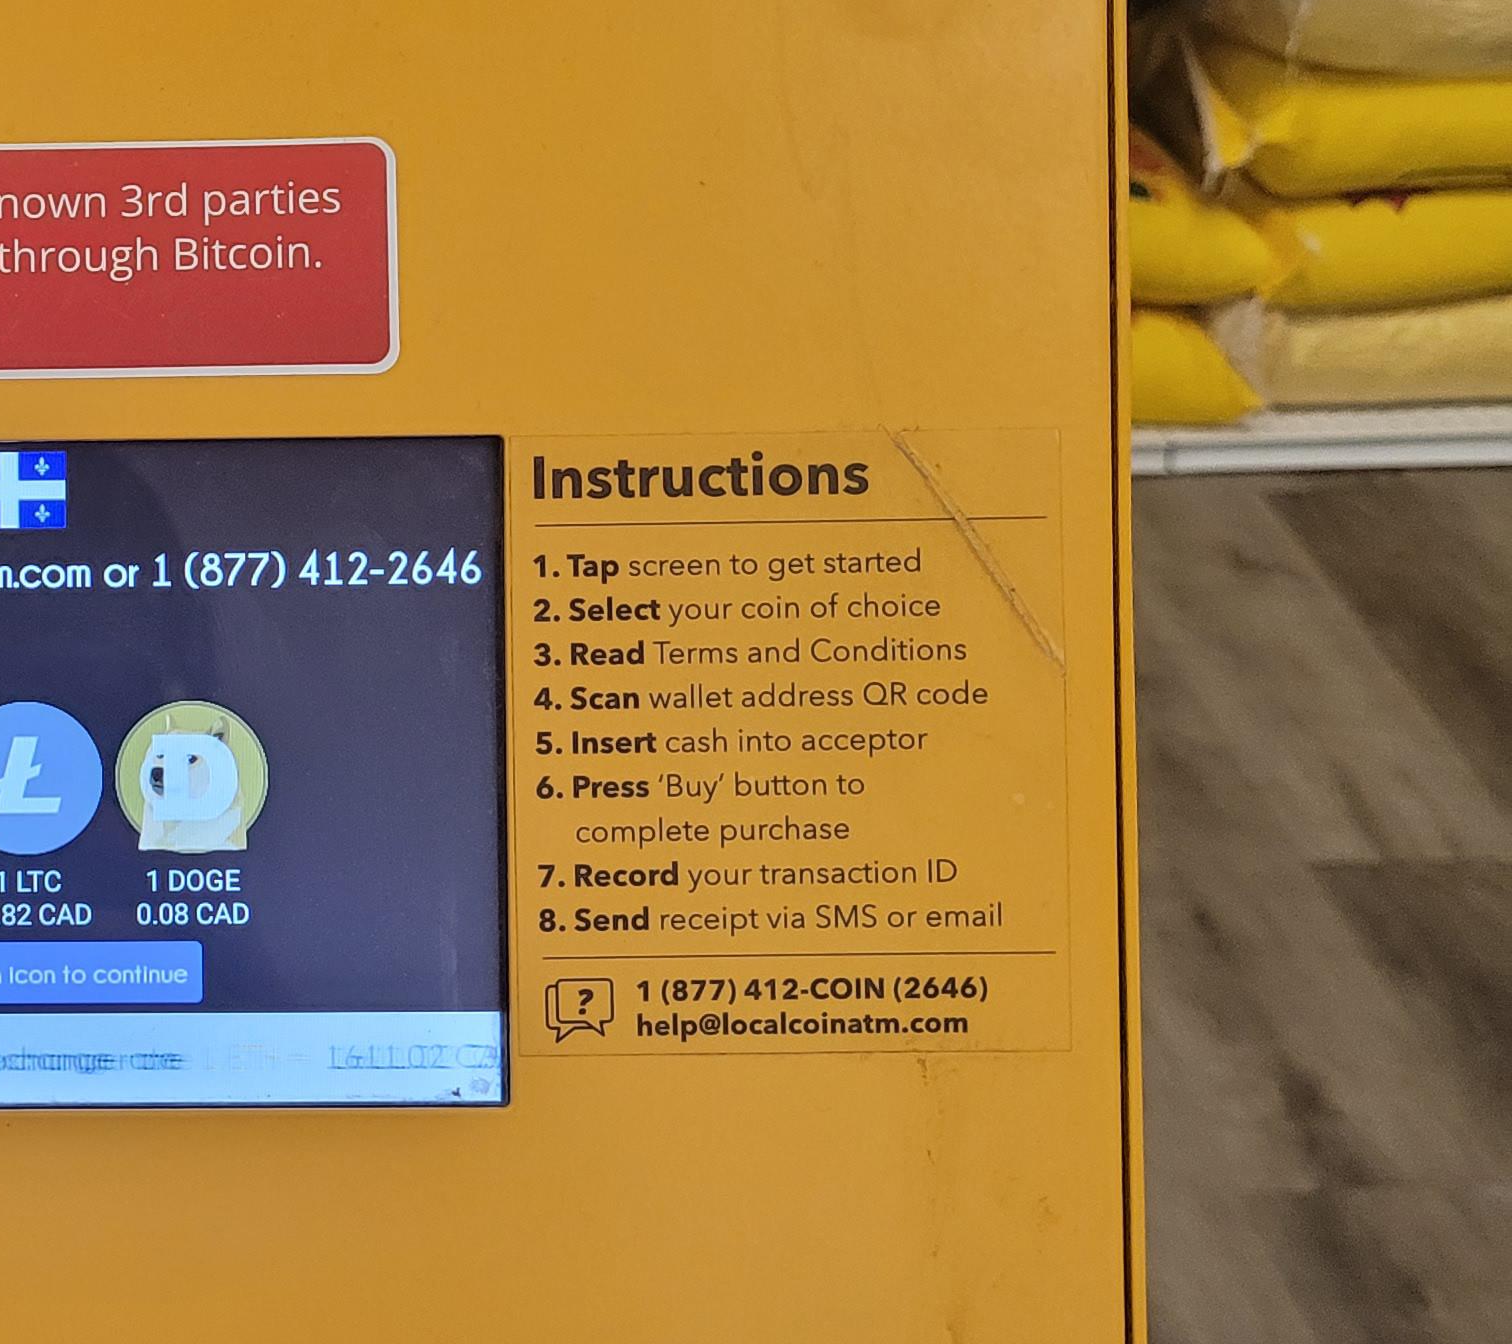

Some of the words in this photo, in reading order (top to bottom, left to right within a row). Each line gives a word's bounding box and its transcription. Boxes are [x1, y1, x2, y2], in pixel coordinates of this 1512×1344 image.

[122, 183, 186, 217] 3rd
[205, 182, 340, 225] parties
[176, 236, 321, 270] Bitcoin.
[534, 451, 868, 499] Instructions
[104, 564, 139, 588] or
[153, 554, 171, 586] 1
[185, 551, 285, 589] (877)
[299, 548, 481, 585] 412-2646
[533, 555, 559, 577] 1.
[567, 554, 619, 584] Tap
[629, 559, 720, 576] screen
[729, 555, 757, 575] to
[769, 554, 814, 581] get
[824, 547, 920, 573] started
[534, 599, 560, 622] 2.
[569, 597, 660, 621] Select
[669, 603, 732, 627] your
[742, 596, 799, 619] coin
[811, 593, 838, 618] of
[848, 592, 940, 617] choice
[534, 643, 561, 666] 3.
[571, 640, 644, 665] Read
[653, 641, 737, 664] Terms
[748, 638, 799, 663] and
[811, 636, 966, 662] Conditions
[534, 687, 561, 710] 4.
[571, 687, 639, 710] Scan
[649, 684, 732, 708] wallet
[742, 682, 853, 707] address
[864, 682, 907, 705] QR
[917, 680, 987, 705] code
[536, 732, 562, 754] 5.
[573, 731, 656, 754] Insert
[666, 728, 727, 753] cash
[739, 729, 791, 752] into
[802, 730, 928, 757] acceptor
[537, 776, 563, 799] 6.
[573, 776, 649, 798] Press
[735, 772, 826, 796] button
[836, 775, 864, 795] to
[577, 817, 709, 849] complete
[721, 815, 849, 848] purchase
[17, 870, 61, 892] LTC
[147, 870, 156, 891] 1
[169, 869, 240, 891] DOGE
[538, 865, 565, 887] 7.
[575, 861, 678, 887] Record
[688, 869, 752, 893] your
[760, 861, 916, 884] transaction
[928, 859, 957, 883] ID
[39, 903, 91, 925] CAD
[137, 903, 188, 925] 0.08
[197, 903, 249, 924] CAD
[539, 909, 565, 932] 8.
[575, 906, 649, 931] Send
[661, 907, 759, 936] receipt
[767, 906, 805, 928] via
[816, 904, 876, 928] SMS
[888, 911, 917, 927] or
[927, 902, 1001, 927] email
[10, 967, 56, 984] icon
[63, 965, 86, 984] to
[93, 965, 188, 984] continue
[637, 981, 648, 1001] 1
[662, 979, 736, 1005] (877)
[744, 978, 884, 1000] 412-COIN
[894, 976, 987, 1002] (2646)
[638, 1012, 968, 1042] help@localcoinatm.com
